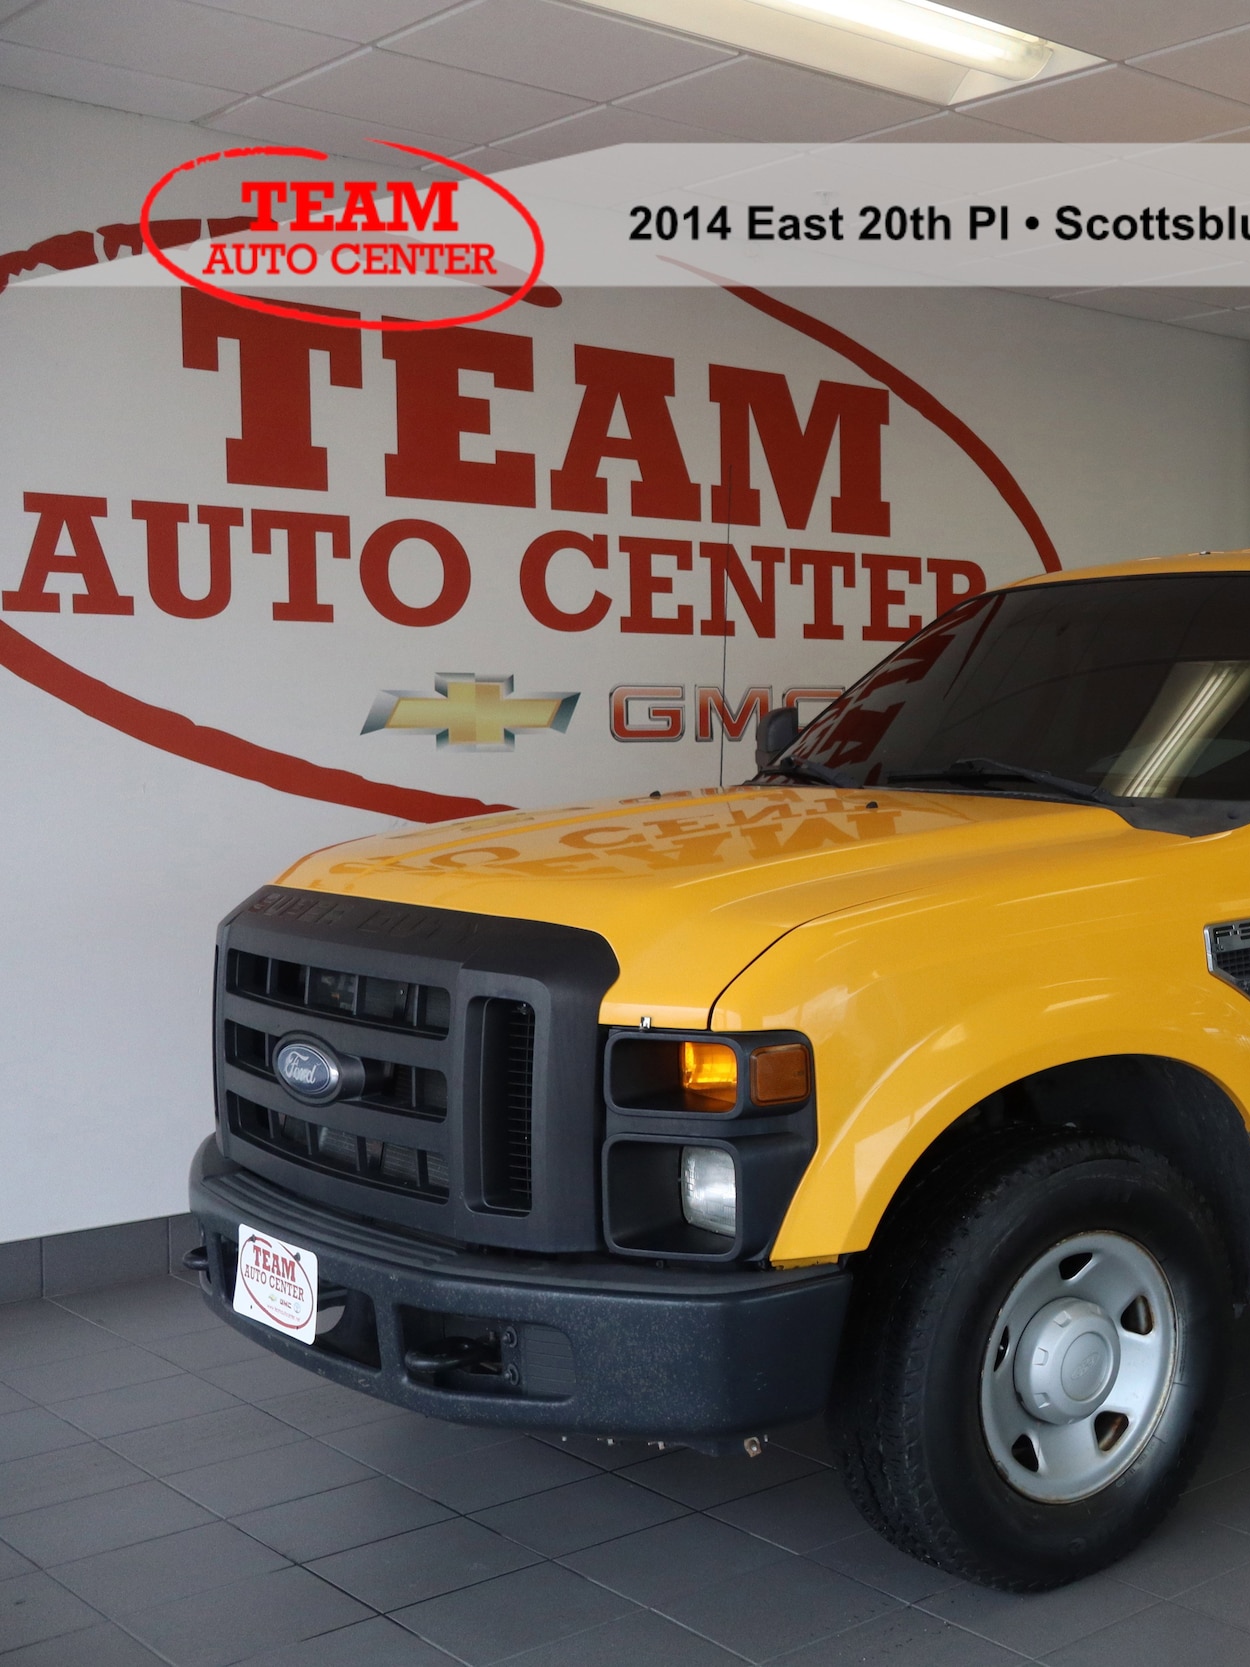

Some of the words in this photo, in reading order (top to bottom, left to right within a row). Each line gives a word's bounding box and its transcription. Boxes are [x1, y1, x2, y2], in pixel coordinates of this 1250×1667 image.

[180, 287, 890, 537] TEAM
[1, 491, 471, 627] AUTO
[519, 529, 986, 643] CENTER
[285, 1051, 317, 1084] Ford
[253, 1245, 296, 1282] TEAM
[244, 1264, 267, 1285] AUTO
[269, 1275, 305, 1302] CENTER
